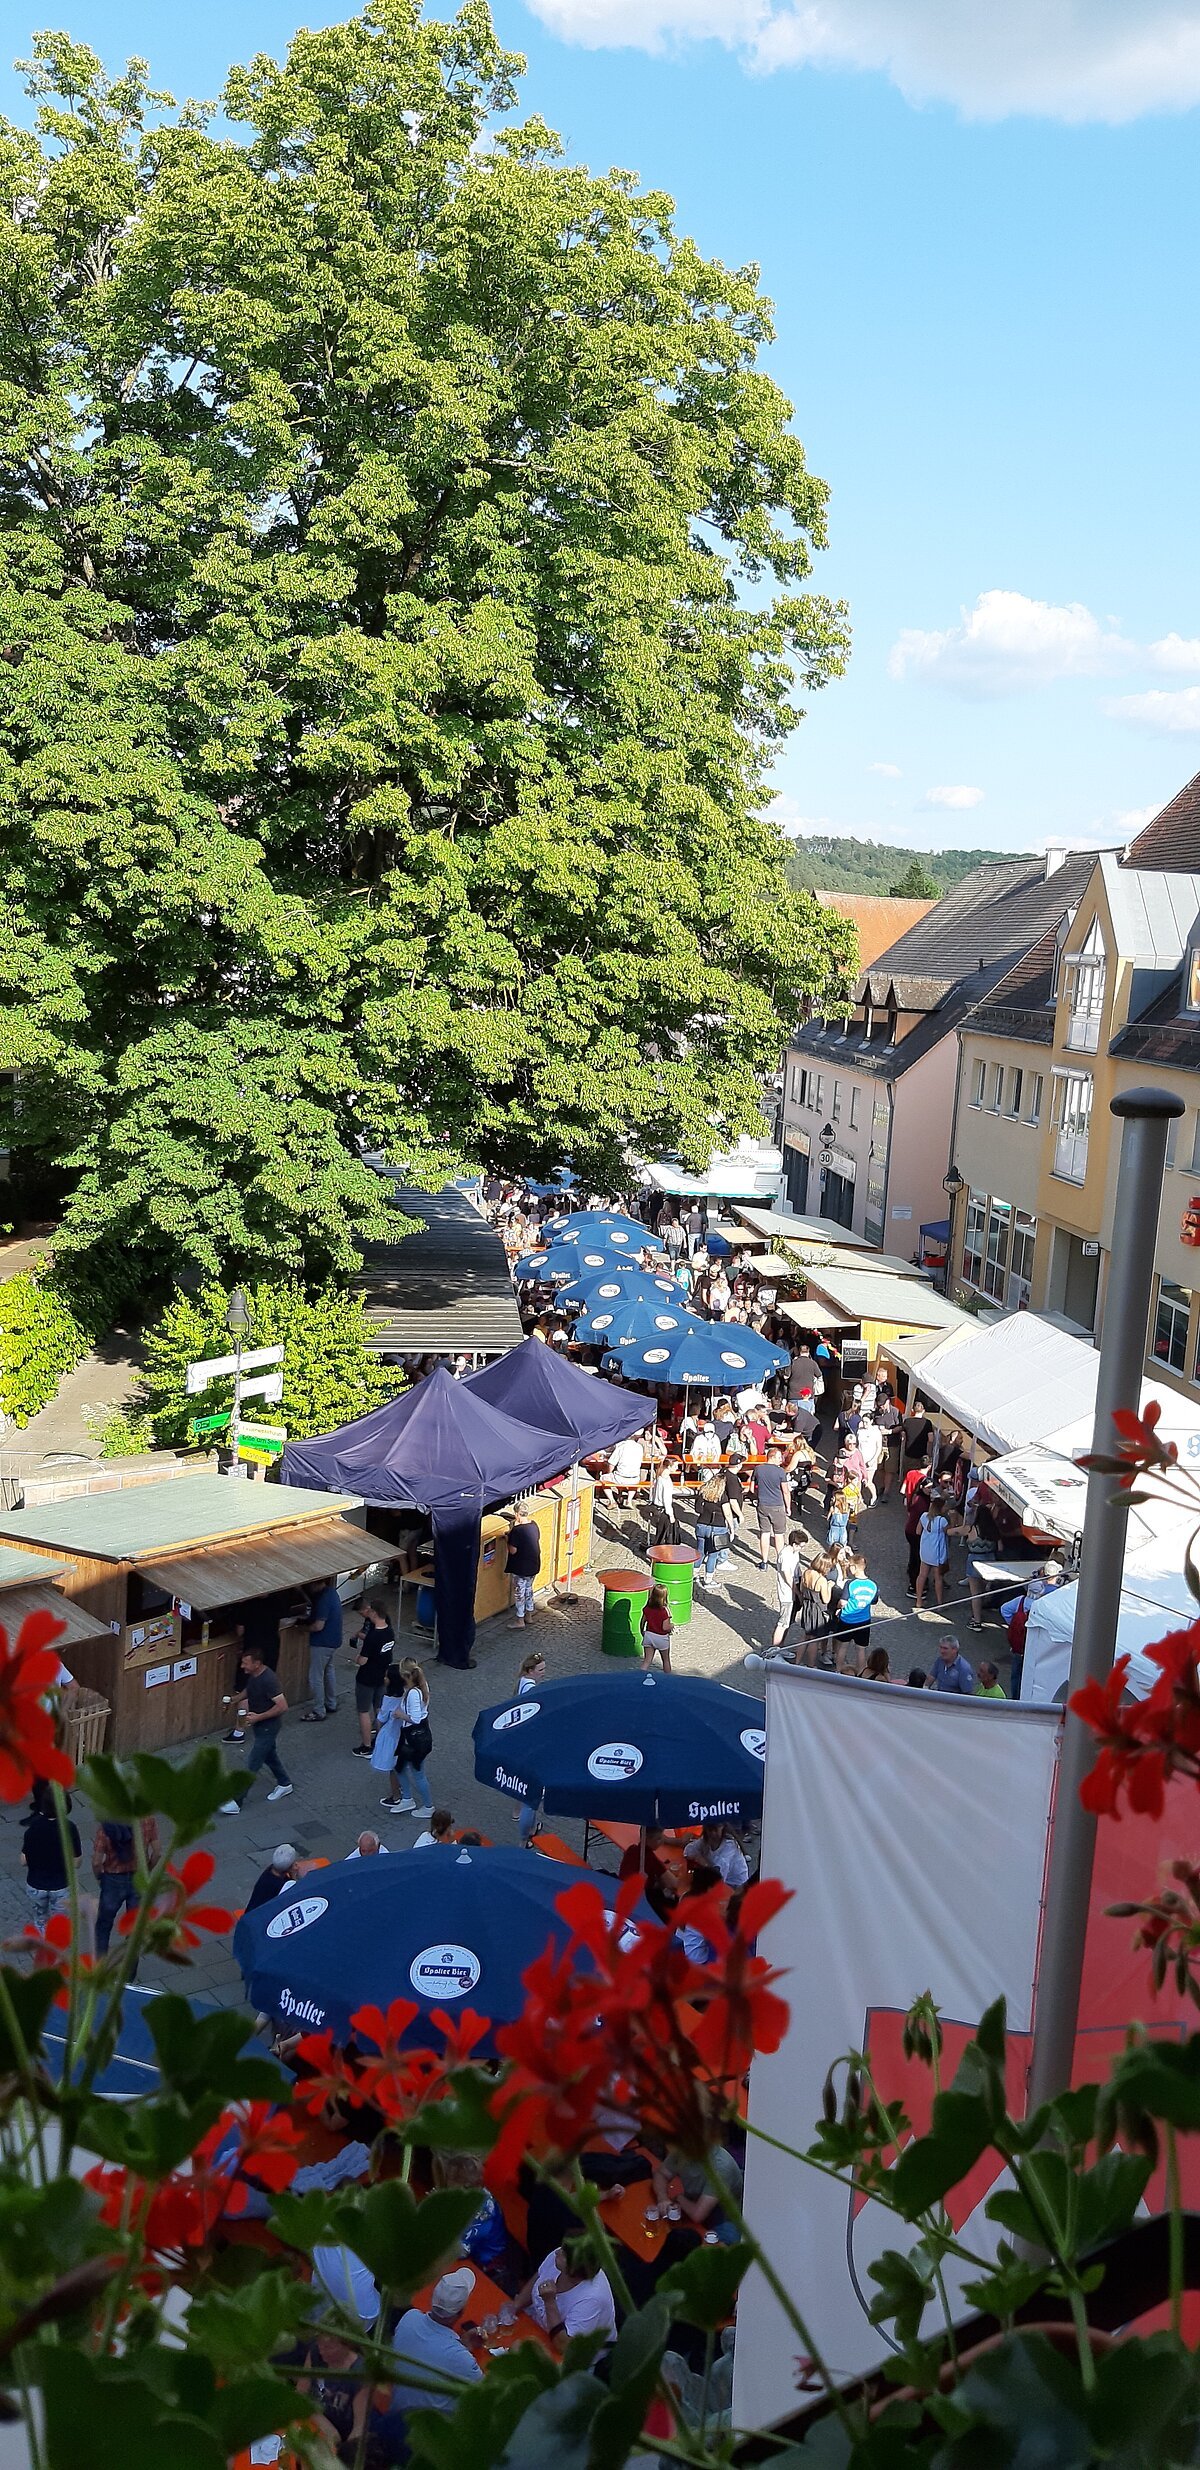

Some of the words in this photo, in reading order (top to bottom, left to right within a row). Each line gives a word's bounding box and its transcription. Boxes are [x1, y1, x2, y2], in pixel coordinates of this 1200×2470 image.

[820, 1154, 830, 1162] 30
[683, 1373, 710, 1383] Spalter
[495, 1766, 528, 1796] Spalter
[688, 1800, 740, 1821] Spalter
[424, 1966, 450, 1975] Spalter
[452, 1968, 467, 1976] Bier
[279, 1988, 326, 2026] Spalter
